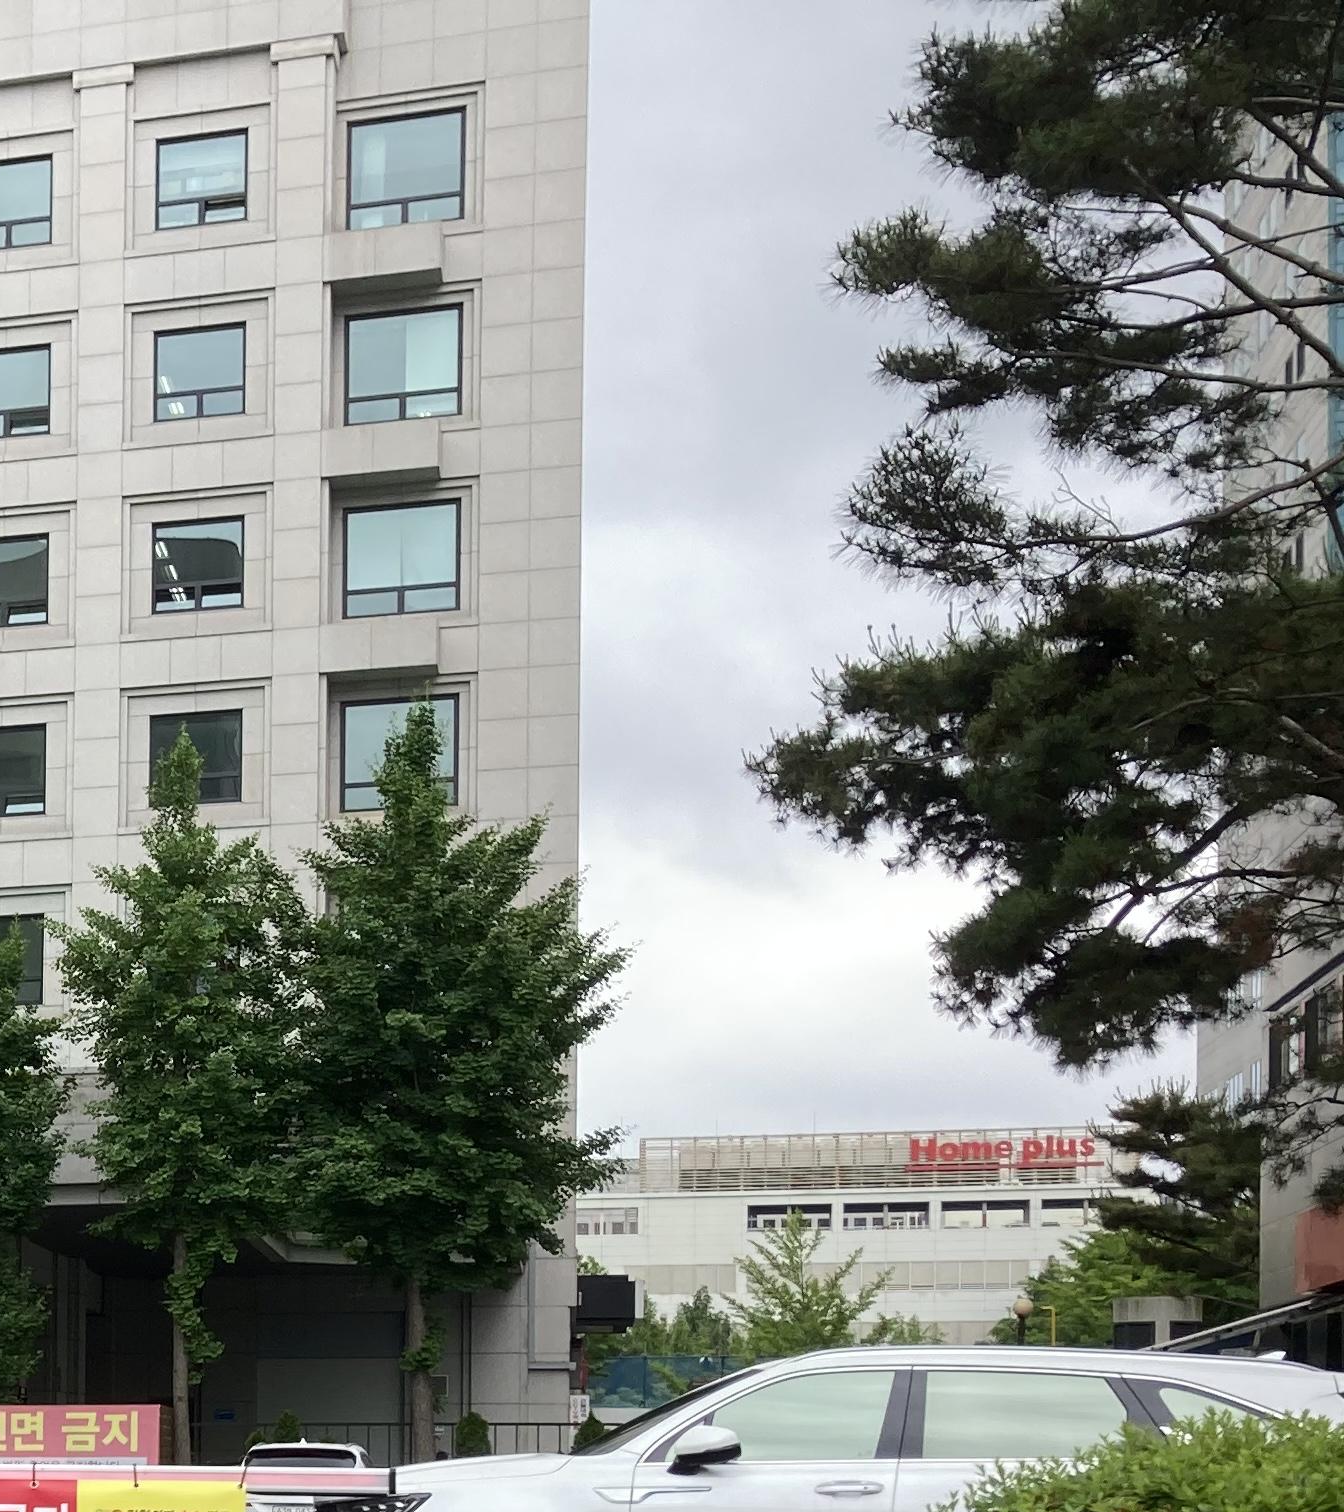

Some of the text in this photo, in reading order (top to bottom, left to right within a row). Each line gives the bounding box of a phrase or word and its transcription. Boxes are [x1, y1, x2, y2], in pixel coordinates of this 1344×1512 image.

[909, 1134, 1095, 1164] Home plus
[61, 1411, 139, 1453] 금지
